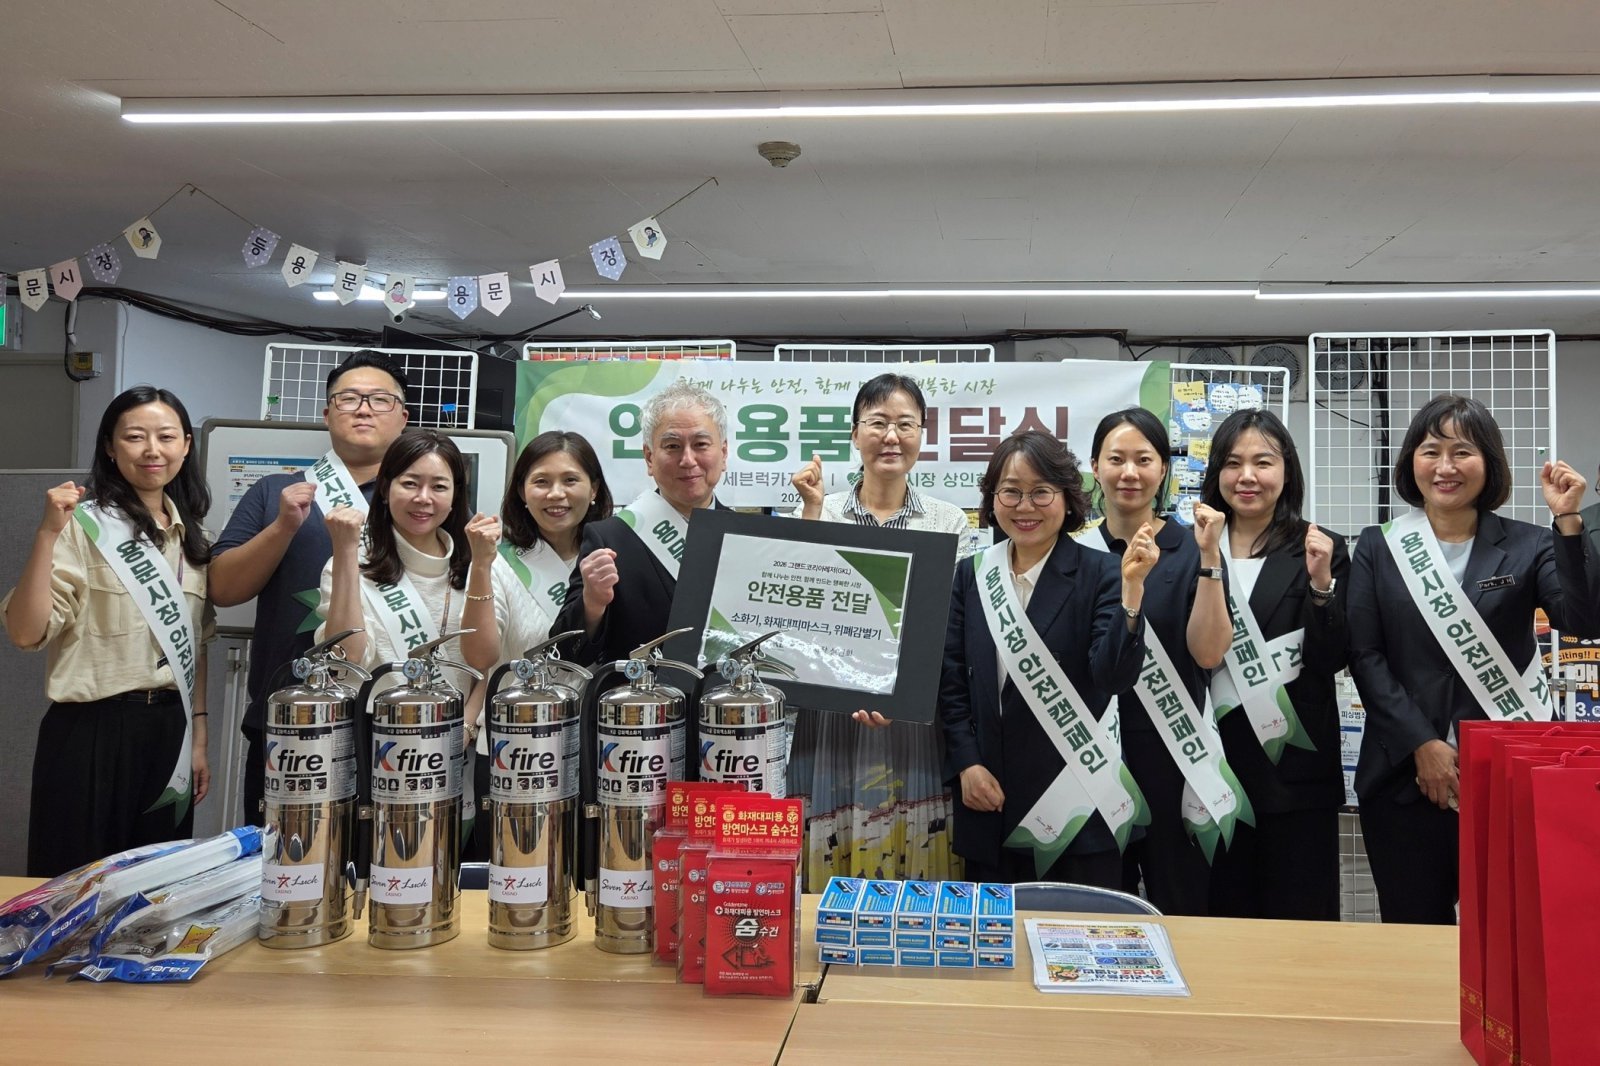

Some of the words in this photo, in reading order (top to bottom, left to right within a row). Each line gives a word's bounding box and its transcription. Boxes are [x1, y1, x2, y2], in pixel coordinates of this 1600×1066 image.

[720, 378, 764, 394] 나누는
[770, 378, 808, 394] 안전,
[815, 376, 851, 394] 함께
[964, 378, 998, 395] 시장
[723, 472, 794, 486] 세븐럭카
[781, 493, 802, 502] 202
[116, 539, 181, 626] 용문시장
[1400, 531, 1459, 620] 용문시장
[747, 580, 825, 610] 안전용품
[830, 590, 872, 615] 전달
[731, 612, 762, 627] 소화기,
[764, 616, 832, 636] 화재대피마스크,
[834, 624, 882, 640] 위폐감별기
[1545, 650, 1590, 664] Eciting!!
[984, 565, 1028, 654] 용문시장
[1018, 652, 1109, 775] 안전캠페인
[738, 811, 784, 822] 화재대피용
[722, 823, 768, 836] 방연마스크
[771, 824, 799, 836] 숨수건
[291, 875, 318, 886] Luck
[401, 879, 428, 889] Luck
[517, 878, 542, 888] Luck
[638, 880, 654, 891] Lu
